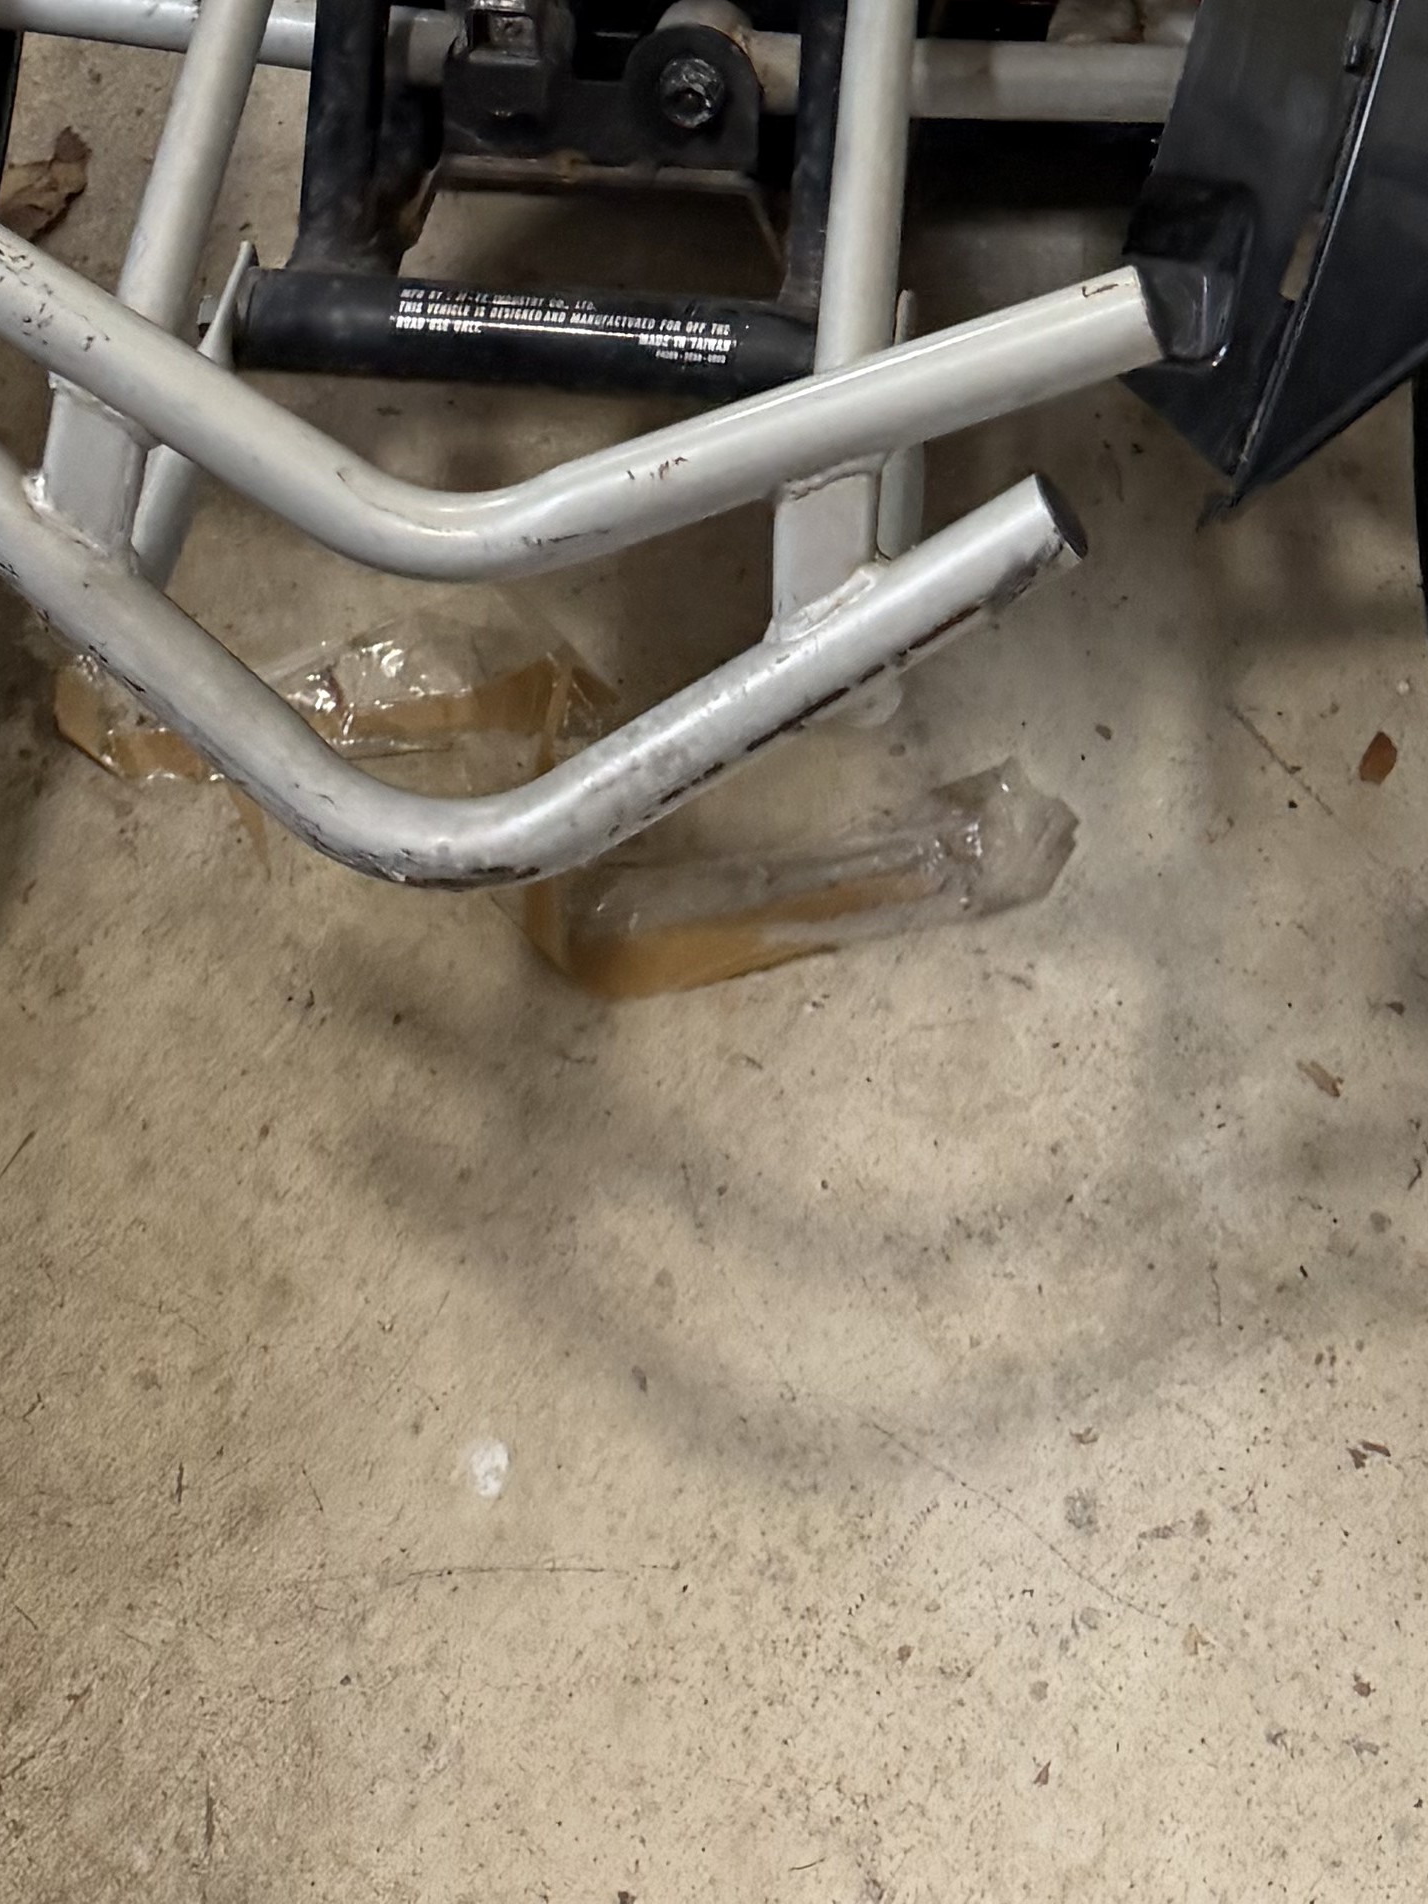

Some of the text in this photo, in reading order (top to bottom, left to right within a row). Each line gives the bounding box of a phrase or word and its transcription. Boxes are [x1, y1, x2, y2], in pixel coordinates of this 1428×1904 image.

[398, 300, 731, 336] THIS VEHICLE IS DESIGNED AND MANUFACTURED FOR OFF THE
[638, 333, 669, 348] MADE
